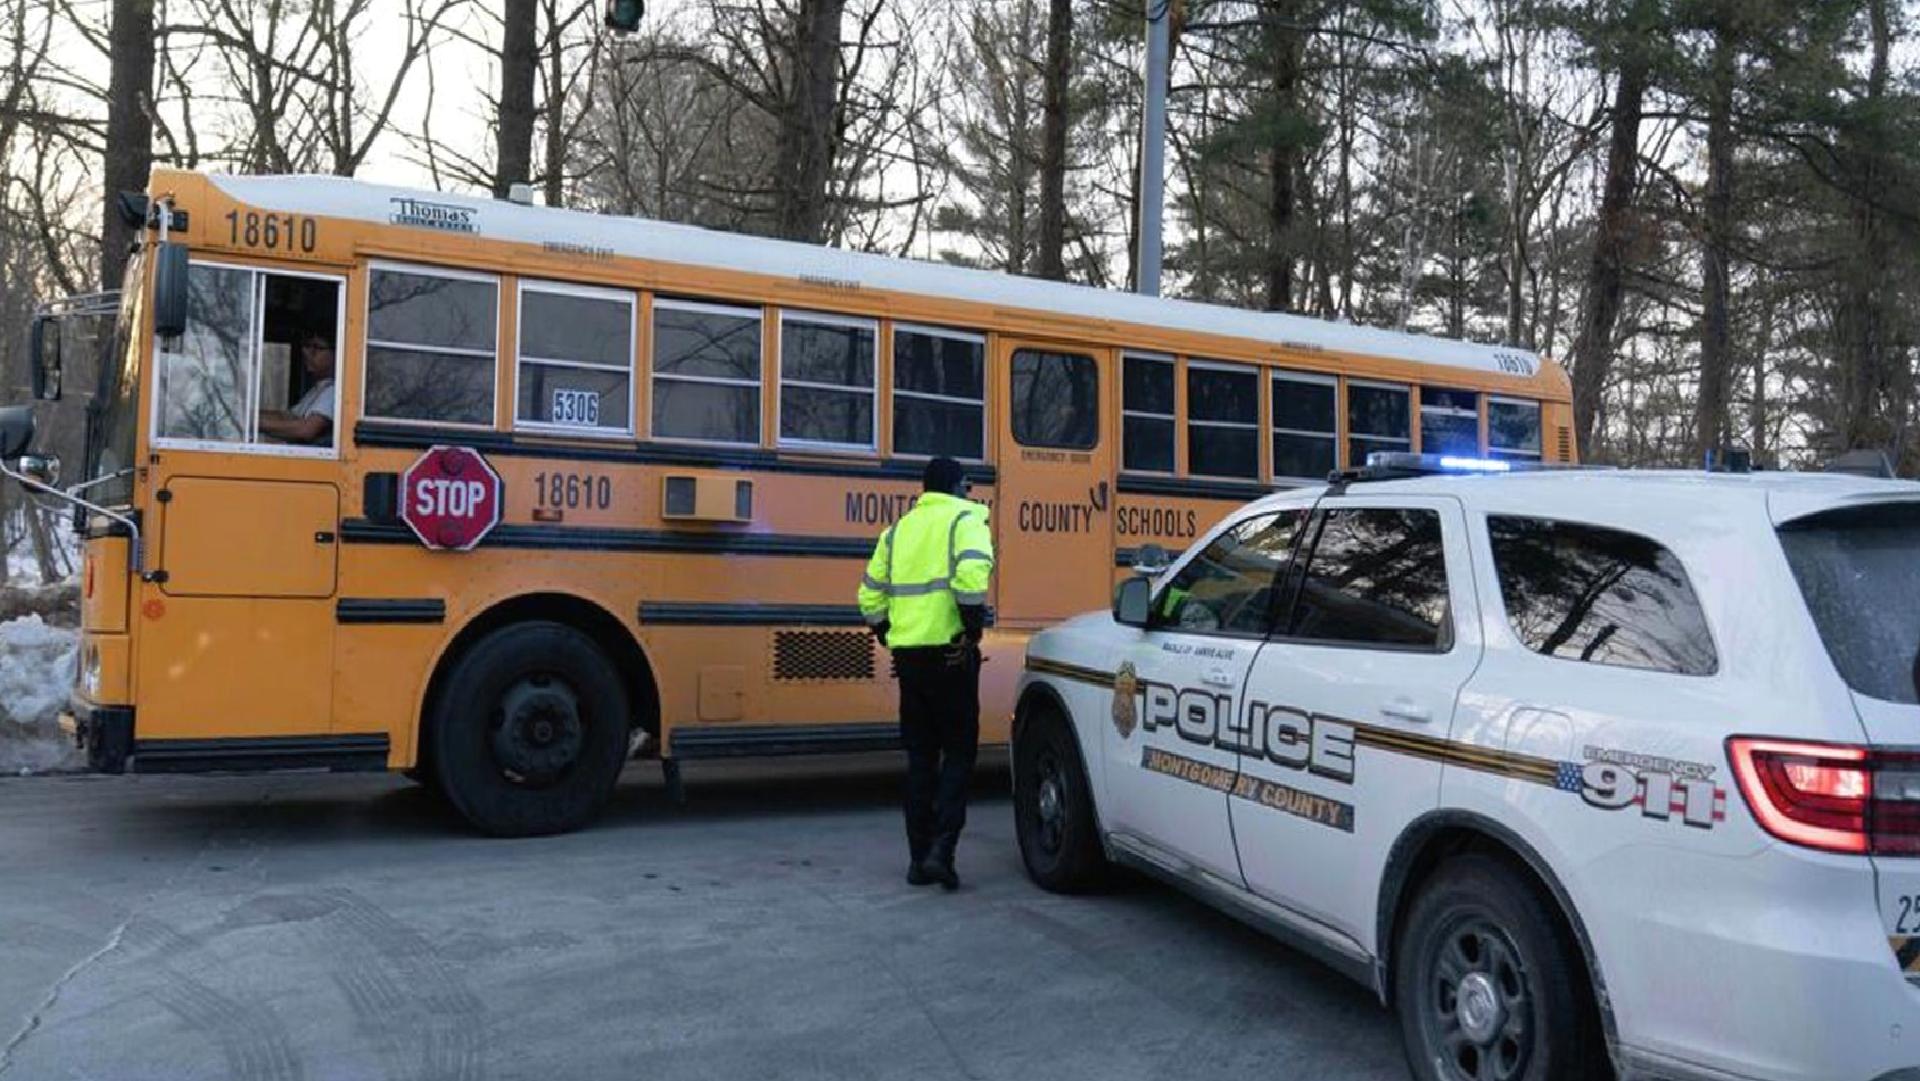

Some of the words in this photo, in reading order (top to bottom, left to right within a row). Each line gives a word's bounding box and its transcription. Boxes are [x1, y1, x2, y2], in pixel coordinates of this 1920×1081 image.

[390, 198, 477, 223] Thomas
[225, 210, 317, 254] 18610
[555, 392, 597, 422] 5306
[416, 480, 486, 517] STOP
[534, 472, 610, 509] 18610
[1019, 502, 1093, 533] COUNTY
[1116, 506, 1197, 537] SCHOOLS
[1142, 683, 1355, 784] POLICE
[1584, 745, 1716, 780] EMERGENCY
[1150, 751, 1258, 800] MONTGOMERY
[1261, 783, 1341, 824] COUNTY
[1581, 761, 1716, 830] 911
